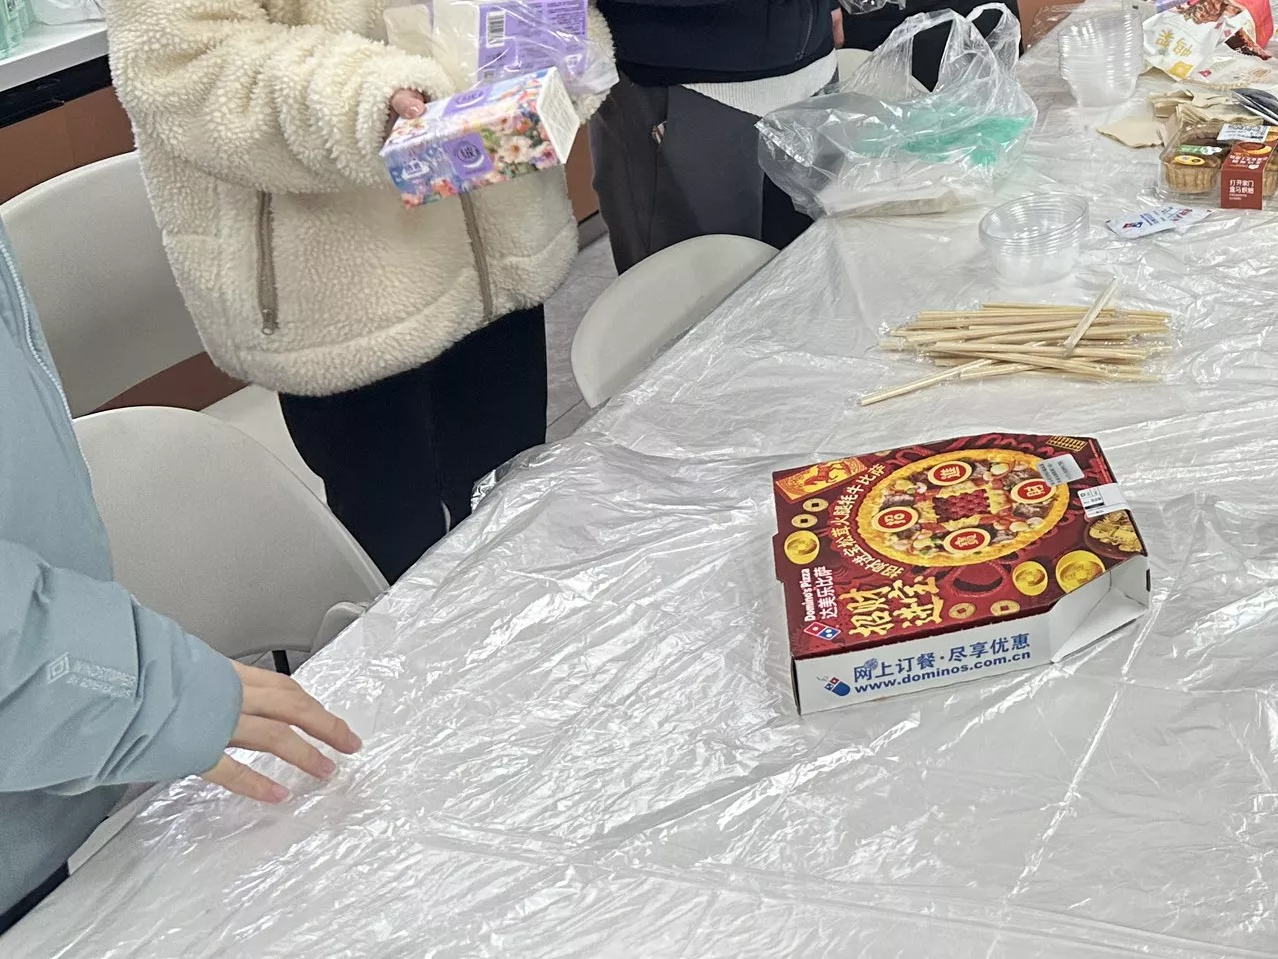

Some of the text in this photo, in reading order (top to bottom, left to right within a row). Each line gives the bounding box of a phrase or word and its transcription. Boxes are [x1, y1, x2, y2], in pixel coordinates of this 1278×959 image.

[801, 568, 816, 623] Domino's Pizza
[819, 566, 836, 620] 达美乐比萨
[841, 582, 894, 638] 招财
[854, 632, 1032, 682] 网上订餐·尽享优惠
[854, 651, 1032, 694] www.dominos.com.cn
